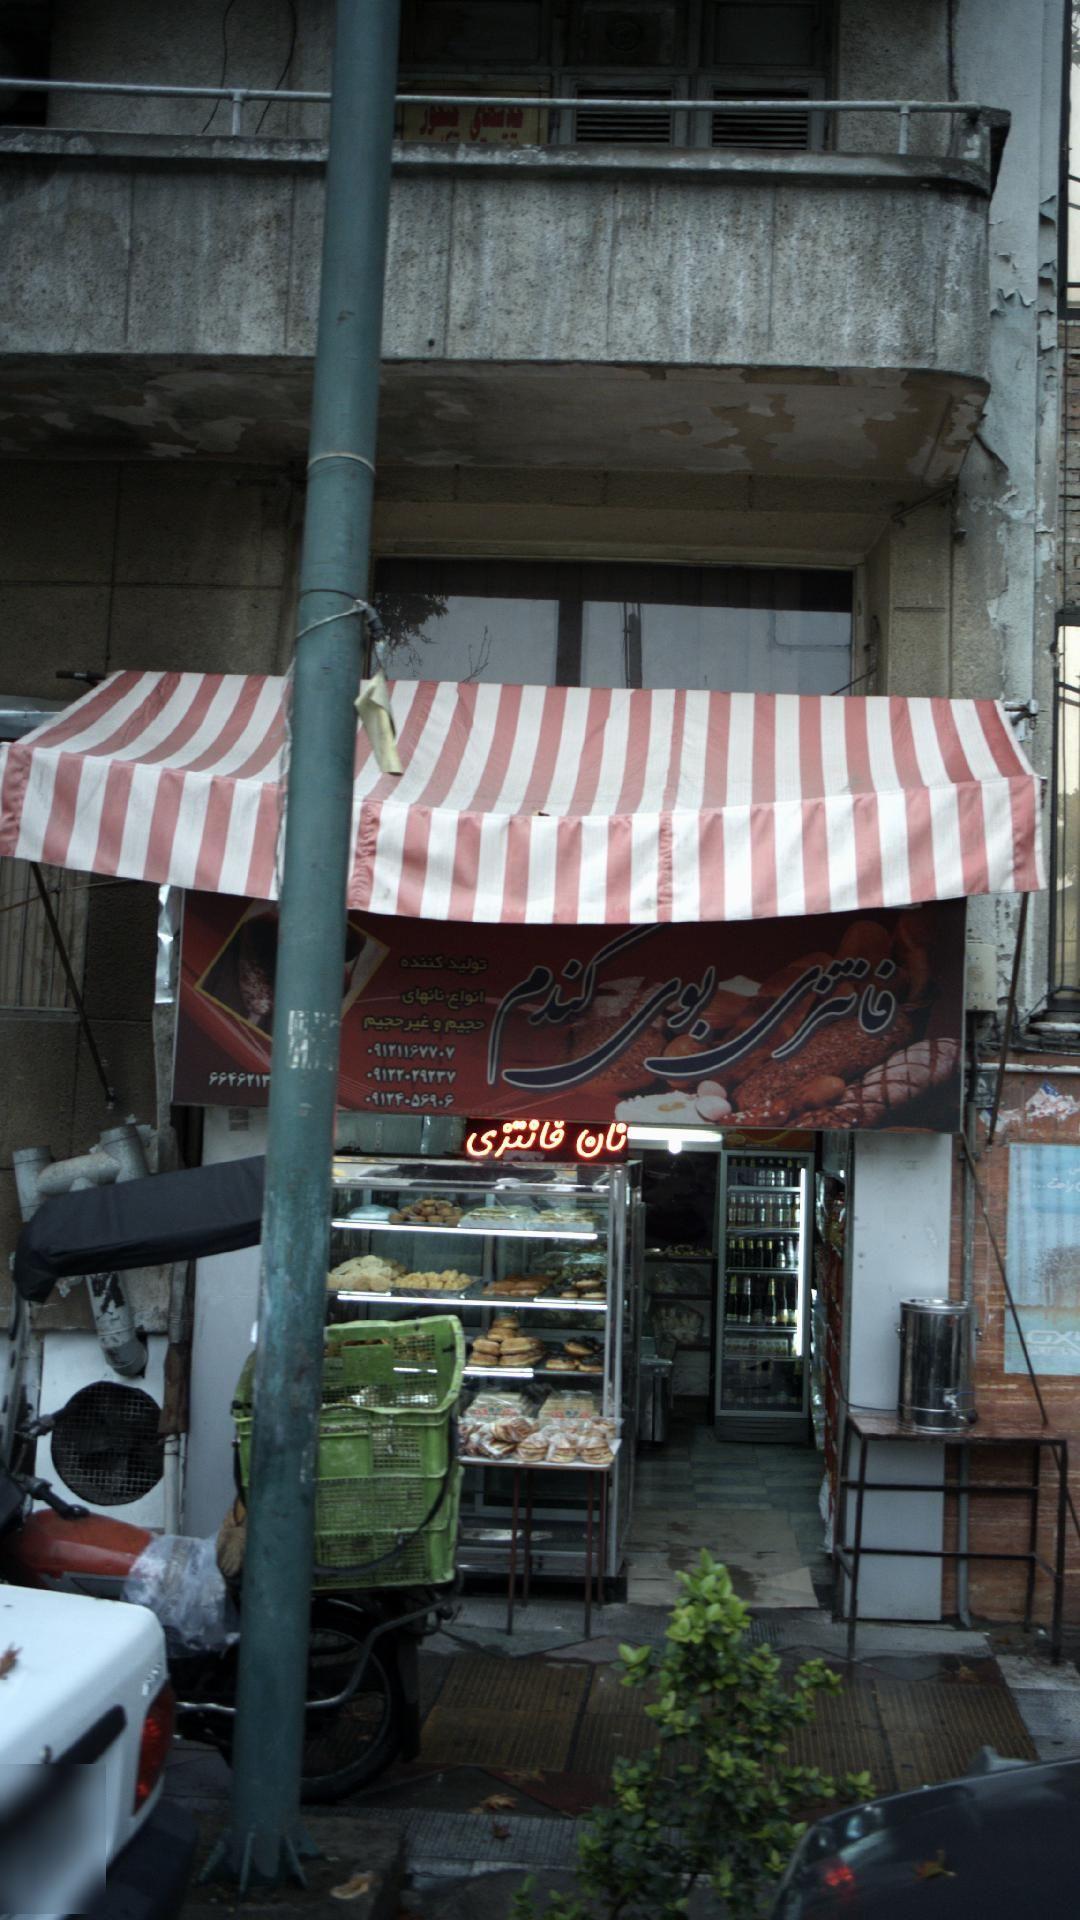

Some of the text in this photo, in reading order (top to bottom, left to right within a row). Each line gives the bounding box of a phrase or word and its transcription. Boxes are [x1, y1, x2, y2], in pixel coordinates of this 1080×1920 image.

[401, 955, 488, 973] تولید کننده
[447, 990, 485, 1010] انواع
[445, 1019, 485, 1034] حجیم
[502, 965, 716, 1090] بوی
[643, 958, 896, 1077] فانتزی
[466, 1119, 628, 1159] نان فانتزی
